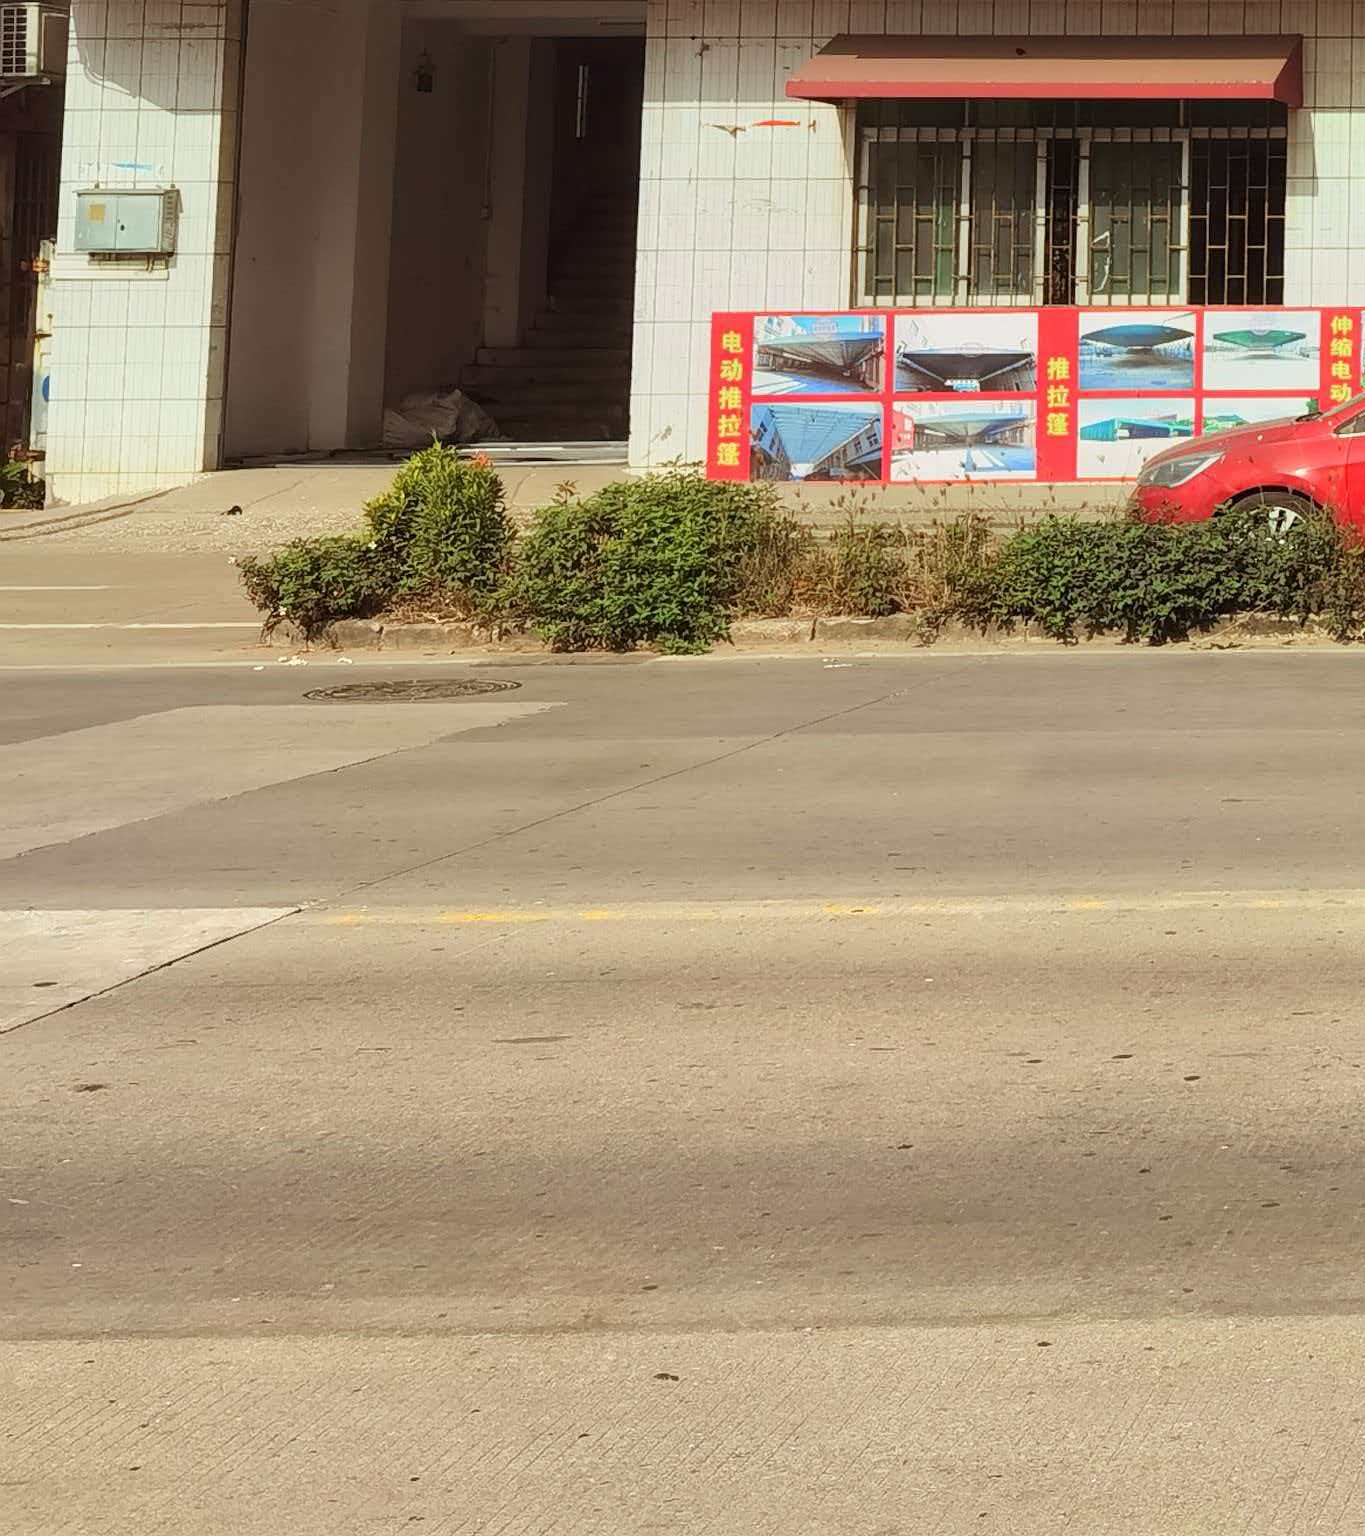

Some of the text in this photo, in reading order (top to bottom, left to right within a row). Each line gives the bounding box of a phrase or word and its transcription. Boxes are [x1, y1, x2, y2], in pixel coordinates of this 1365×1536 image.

[717, 330, 743, 466] 电动推拉篷
[1046, 355, 1070, 437] 推拉篷
[1330, 315, 1353, 402] 伸缩电动
